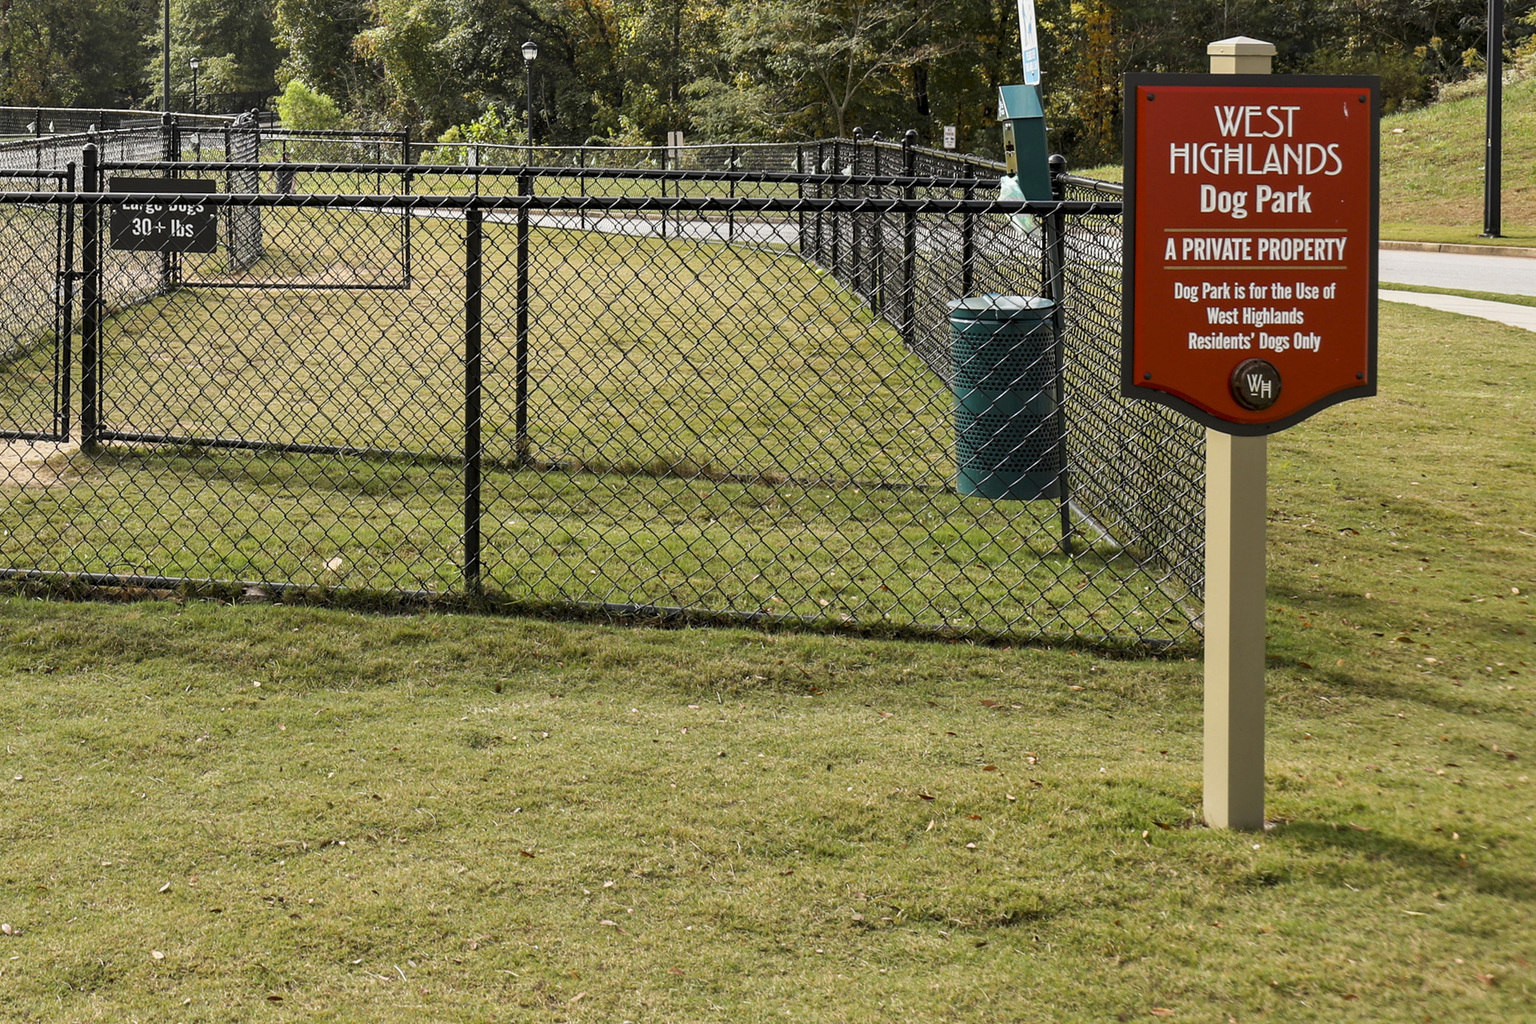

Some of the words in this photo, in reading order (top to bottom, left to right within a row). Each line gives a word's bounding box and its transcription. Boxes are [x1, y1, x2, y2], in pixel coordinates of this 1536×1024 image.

[1214, 105, 1301, 138] WEST
[1170, 142, 1343, 176] HIGHLANDS
[1200, 184, 1248, 219] Dog
[1256, 184, 1313, 213] Park
[171, 219, 194, 238] lbs
[1164, 237, 1177, 261] A
[1182, 237, 1252, 261] PRIVATE
[1257, 237, 1347, 261] PROPERTY
[1174, 282, 1199, 302] Dog
[1202, 282, 1231, 300] Park
[1234, 282, 1246, 300] is
[1249, 282, 1268, 300] for
[1271, 282, 1292, 300] the
[1295, 282, 1319, 300] Use
[1323, 282, 1336, 300] of
[1206, 307, 1239, 324] West
[1242, 307, 1304, 328] Highlands
[1259, 332, 1290, 352] Dogs
[1293, 332, 1322, 352] Only
